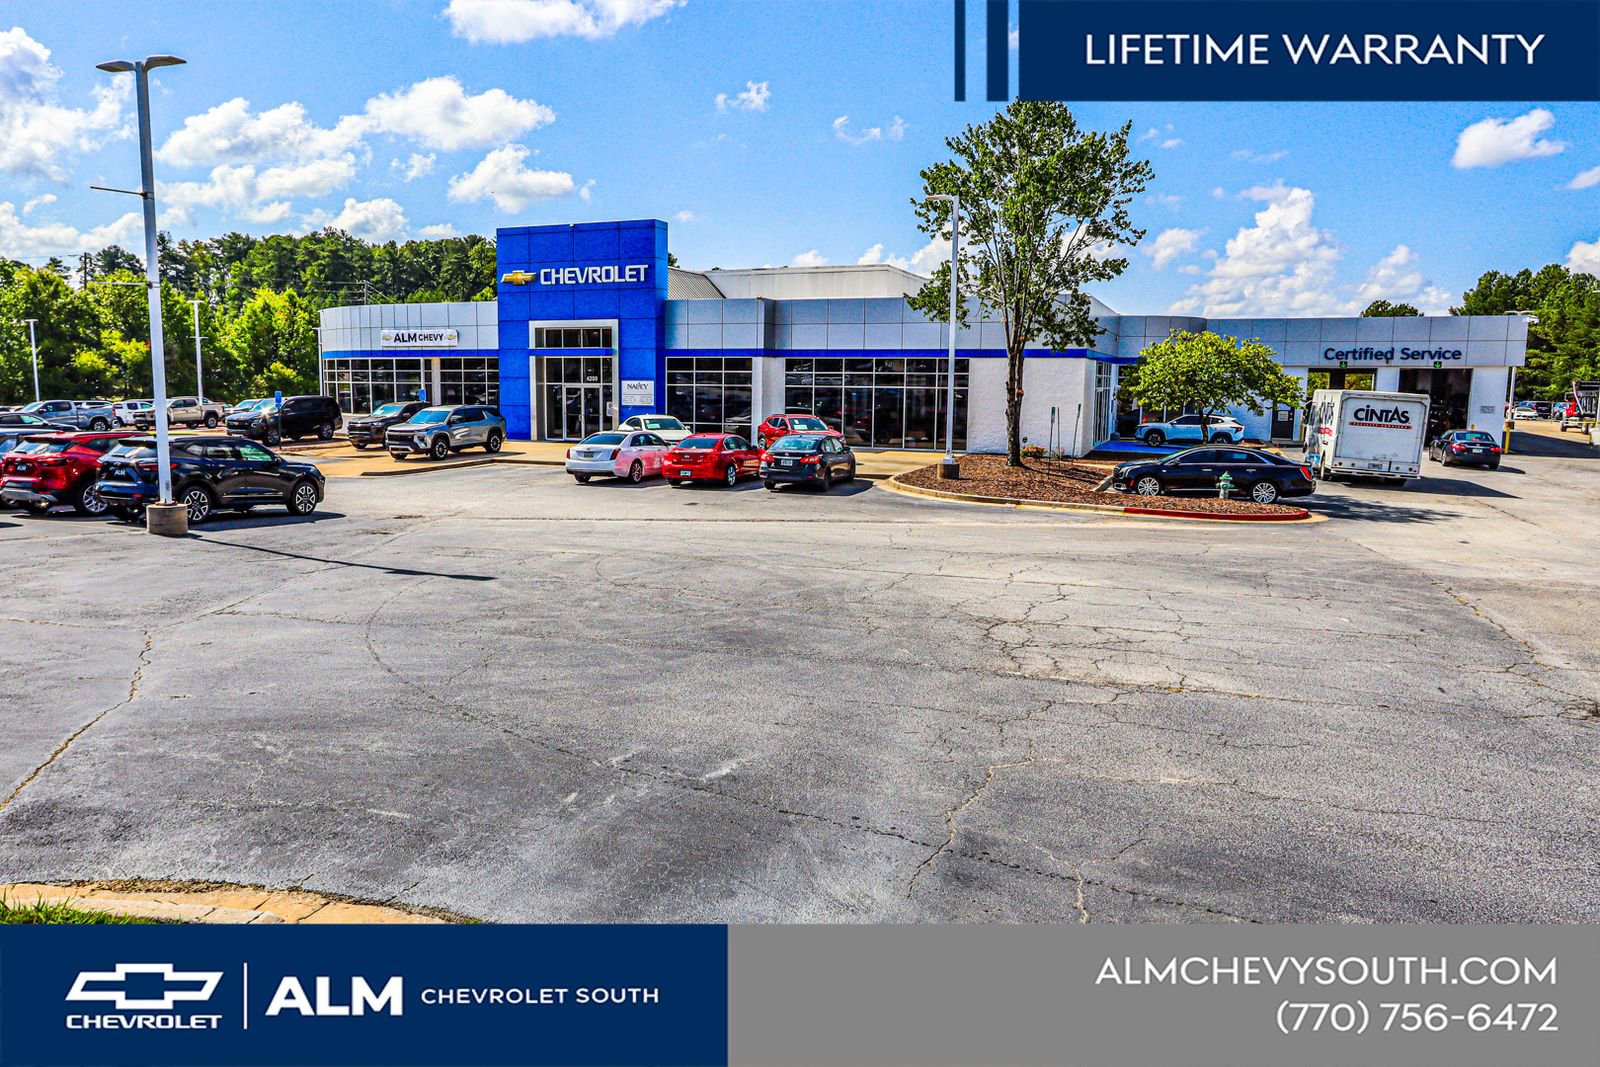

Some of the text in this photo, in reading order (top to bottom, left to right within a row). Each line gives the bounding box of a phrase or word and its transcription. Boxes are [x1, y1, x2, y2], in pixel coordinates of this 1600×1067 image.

[540, 264, 648, 285] CHEVROLET
[394, 332, 444, 343] ALM CHEVY
[1324, 347, 1462, 360] Certified Service
